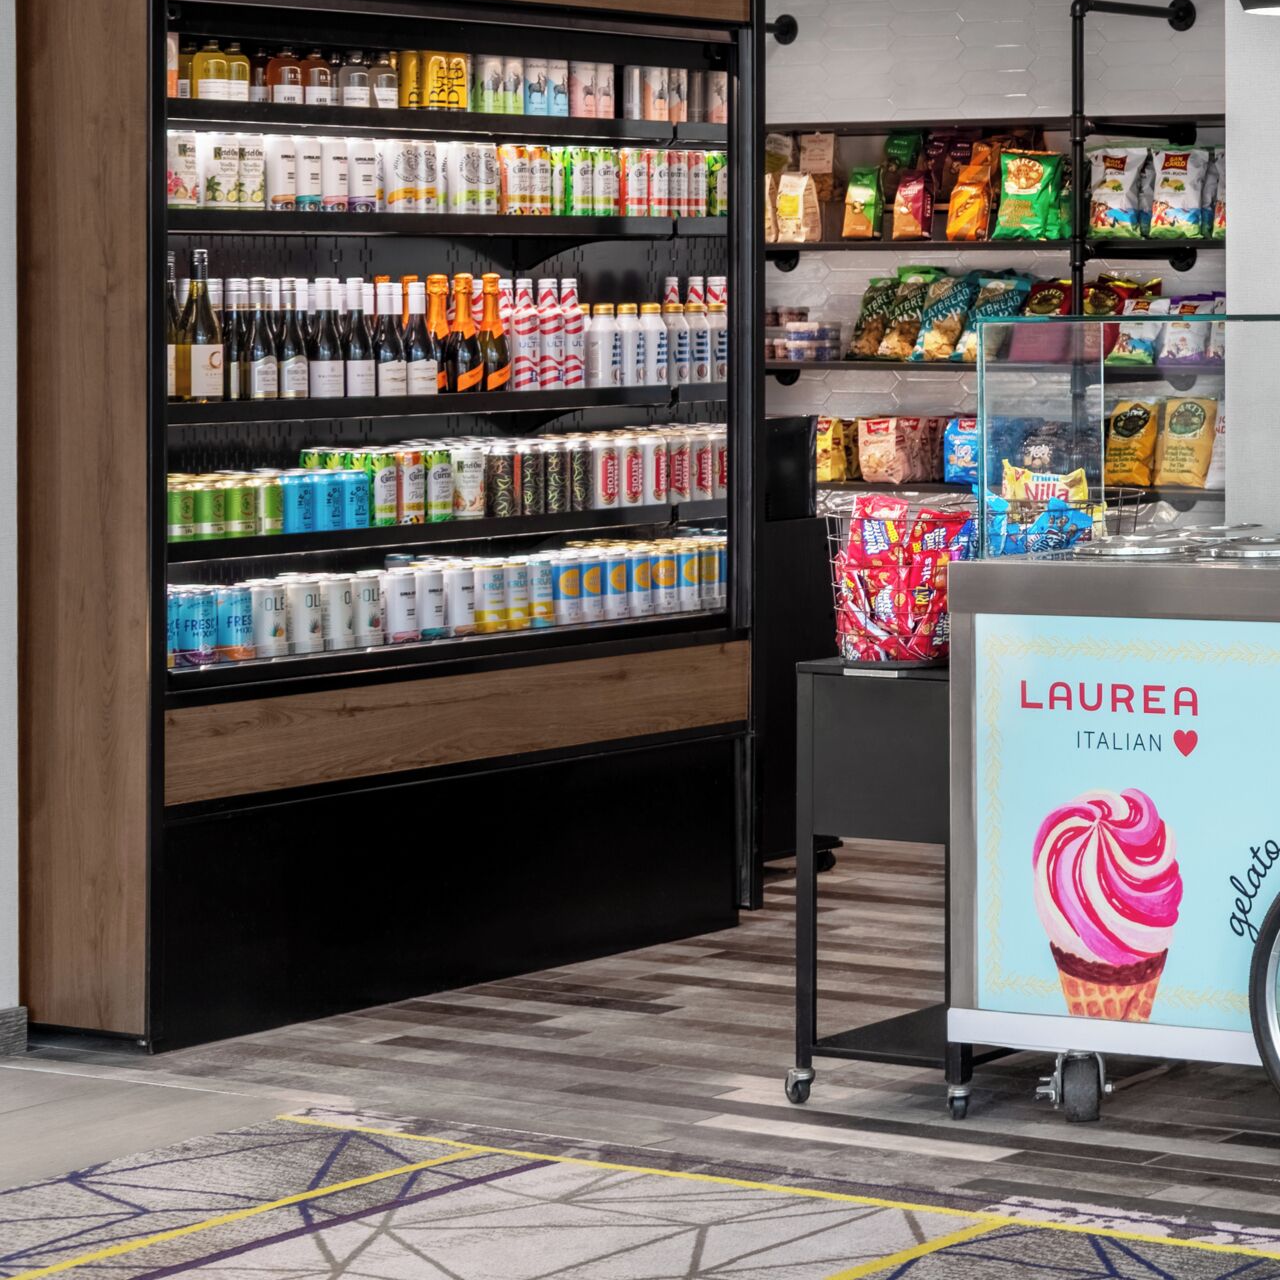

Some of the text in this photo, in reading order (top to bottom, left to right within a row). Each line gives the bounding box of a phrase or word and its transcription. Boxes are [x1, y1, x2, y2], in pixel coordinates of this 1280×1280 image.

[923, 288, 970, 320] LATBREAD
[970, 295, 1021, 320] LATBREAD
[1024, 483, 1069, 502] Nilla
[227, 616, 252, 628] FRES
[1021, 680, 1199, 716] LAUREA
[1077, 730, 1163, 752] ITALIAN
